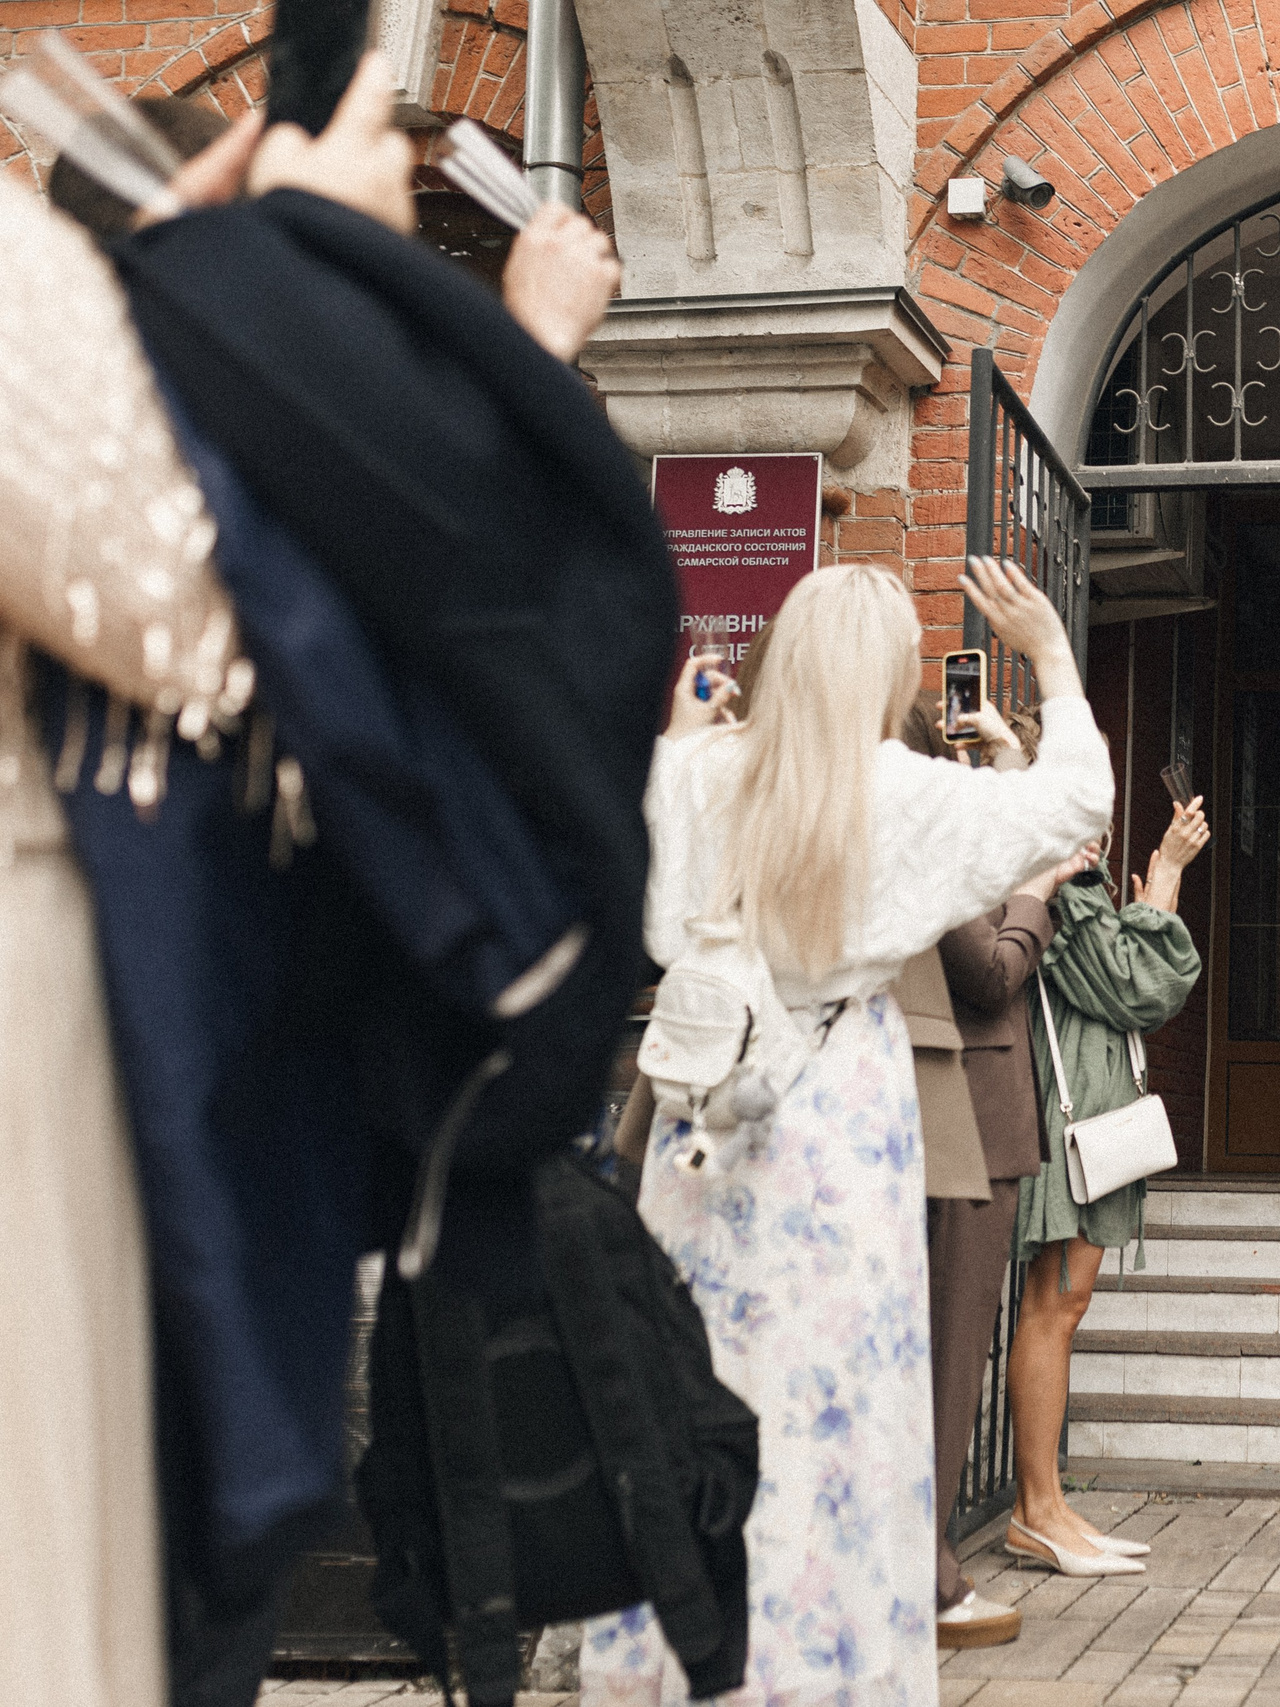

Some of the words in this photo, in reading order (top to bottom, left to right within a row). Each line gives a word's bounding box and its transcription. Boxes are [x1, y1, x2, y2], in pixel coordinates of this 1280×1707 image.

[662, 529, 728, 538] УПРАВЛЕНИЕ
[730, 528, 771, 537] ЗАПИСИ
[772, 528, 807, 537] АКТОВ
[664, 543, 742, 553] РАЖДАНСКОГО
[744, 542, 806, 552] СОСТОЯНИЯ
[677, 556, 739, 566] САМАРСКОЙ
[741, 557, 789, 566] ОБЛАСТИ
